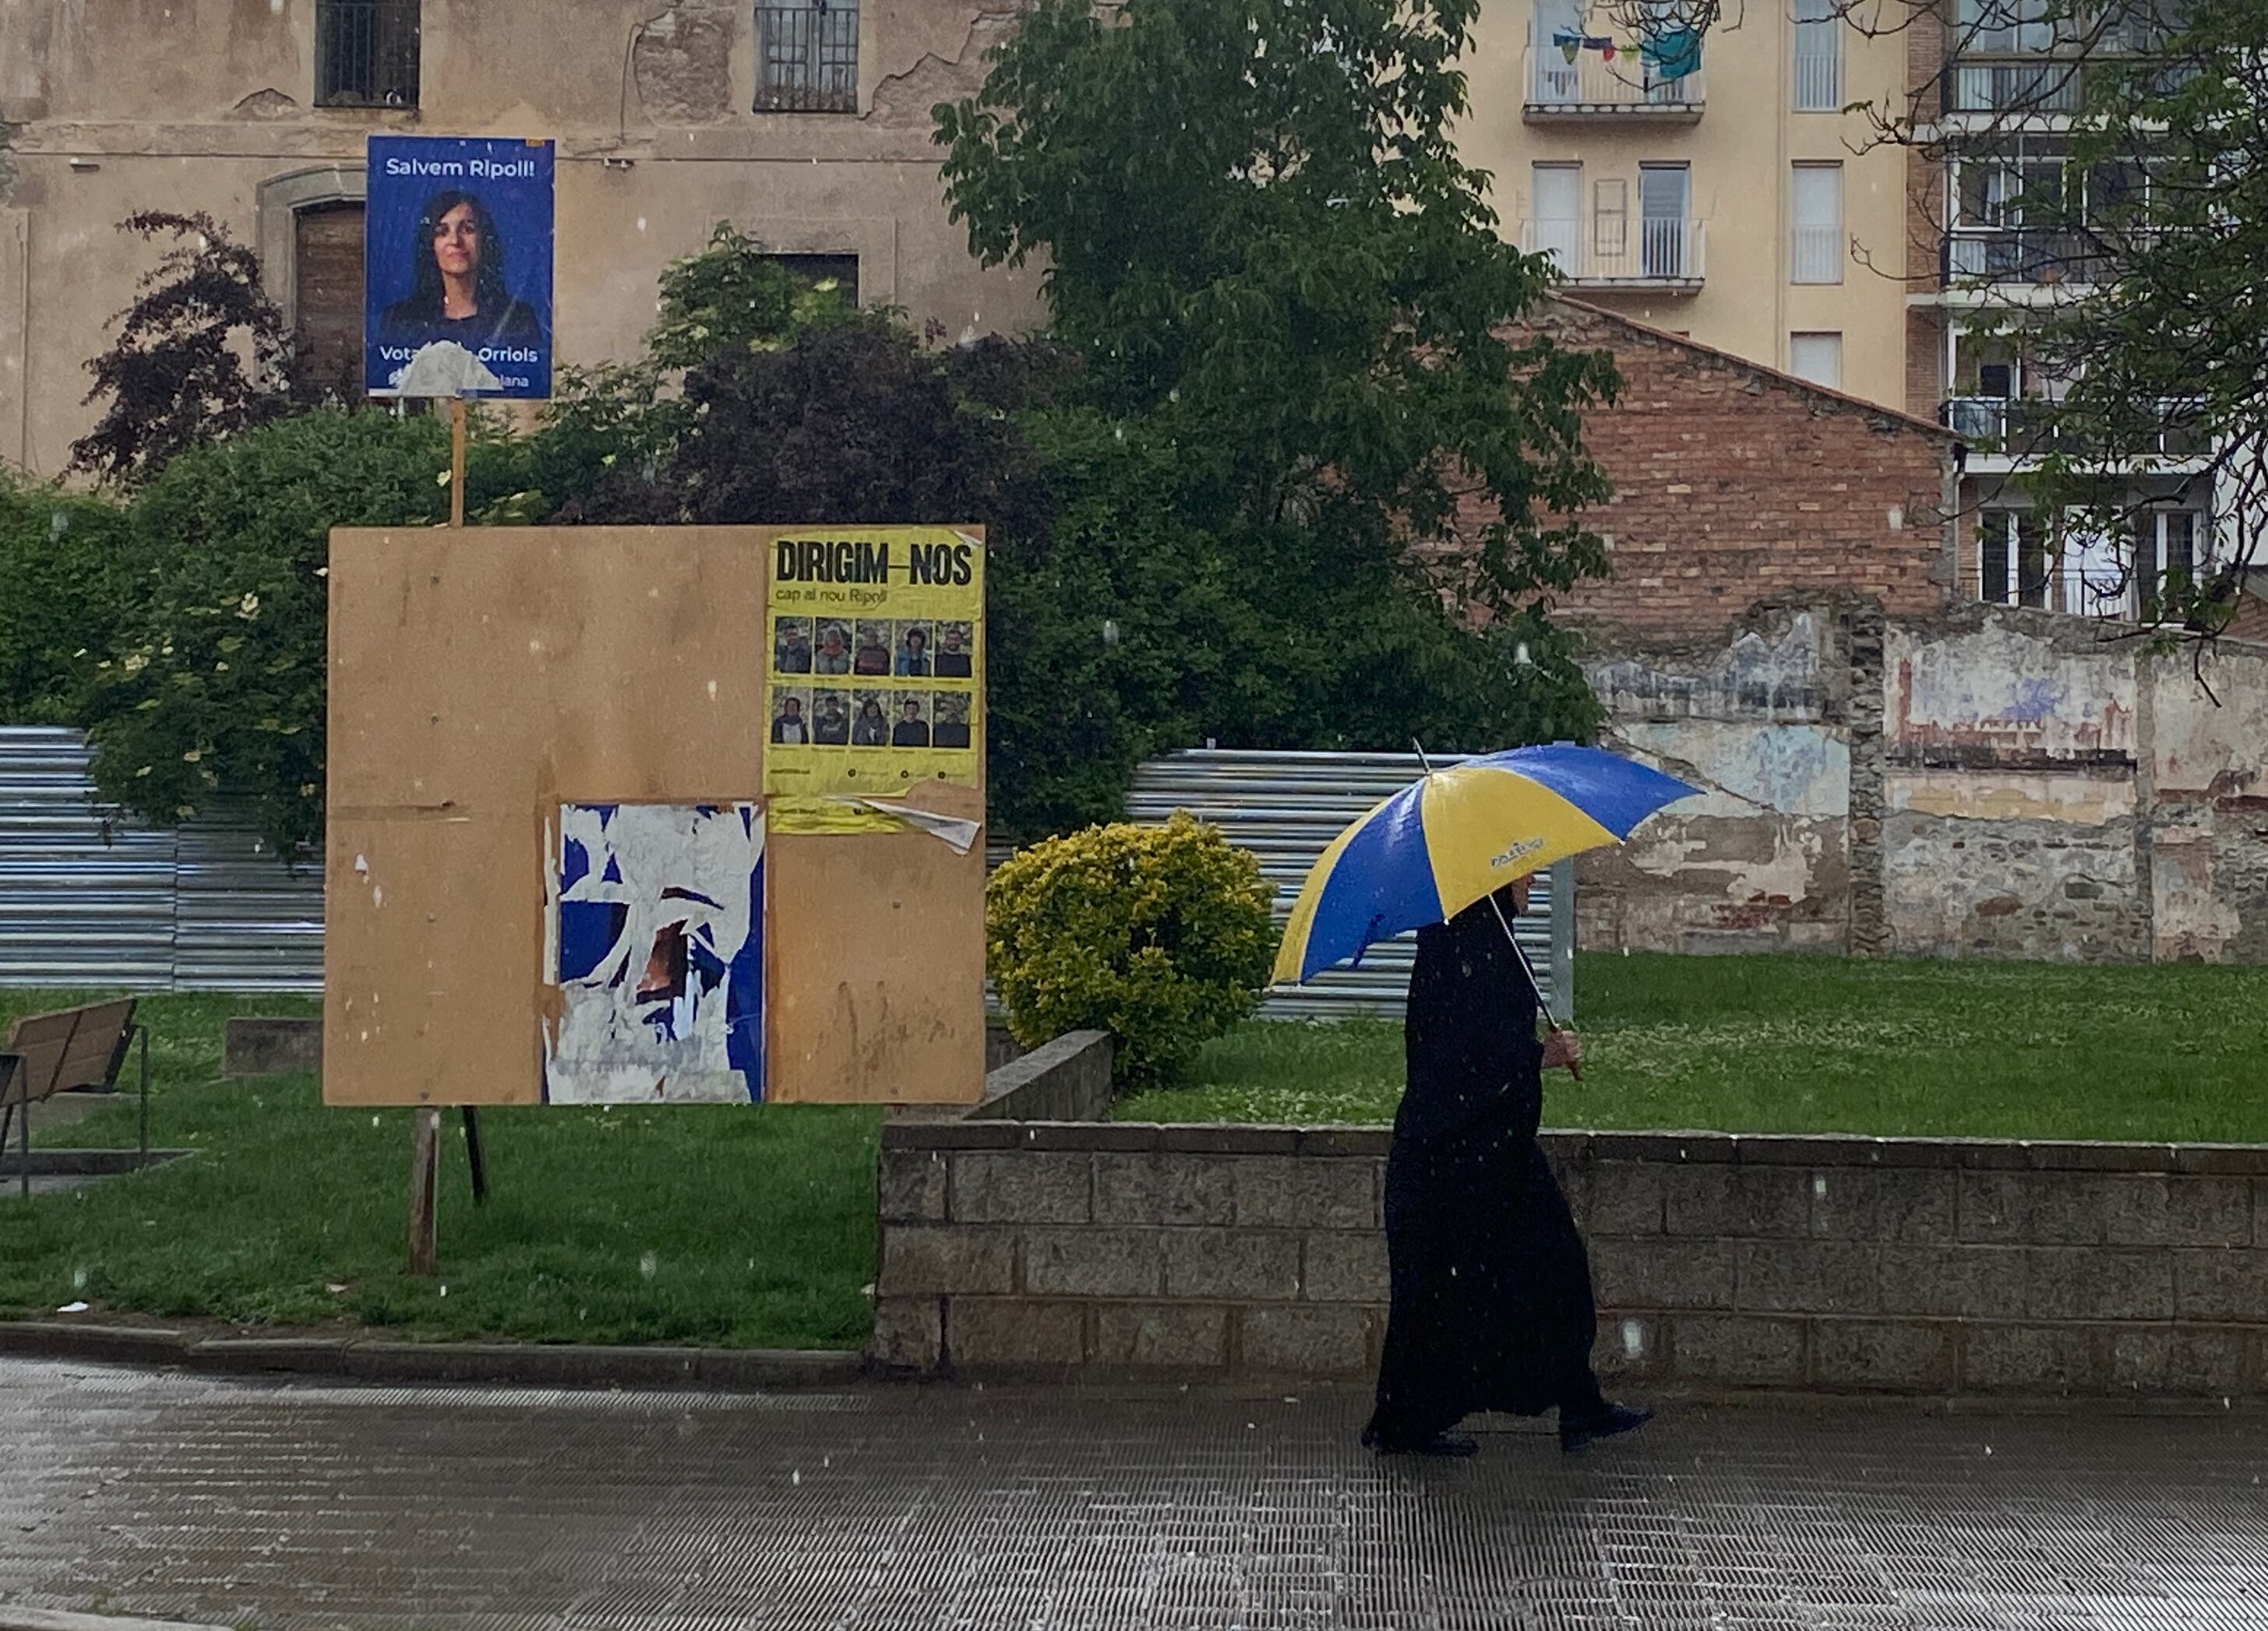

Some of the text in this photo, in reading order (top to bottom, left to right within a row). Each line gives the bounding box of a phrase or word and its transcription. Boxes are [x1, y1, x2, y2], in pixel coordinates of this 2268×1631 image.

[386, 158, 535, 180] Salvem Ripoll!
[379, 345, 538, 362] Vot Orriols
[775, 590, 801, 604] cap
[804, 588, 816, 601] al
[820, 591, 846, 602] nou
